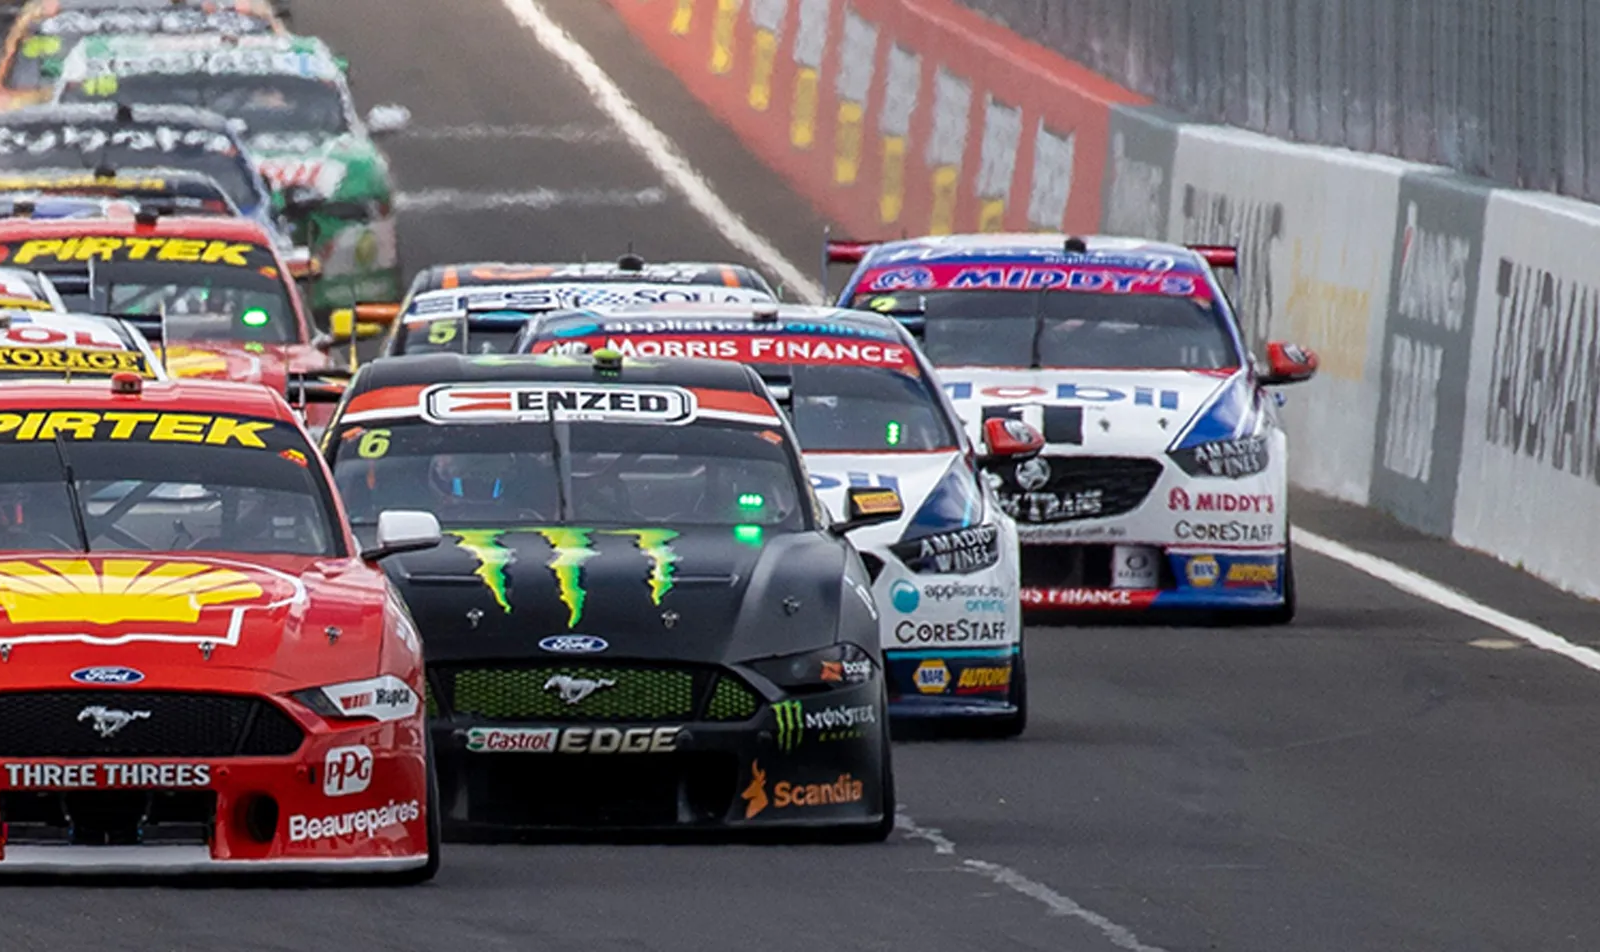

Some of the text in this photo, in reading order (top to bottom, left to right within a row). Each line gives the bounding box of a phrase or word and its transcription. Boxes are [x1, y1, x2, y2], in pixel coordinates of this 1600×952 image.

[12, 238, 256, 267] PIRTEK
[949, 267, 1196, 296] MIDDY'S
[428, 319, 458, 344] 5
[606, 338, 738, 357] MORRIS
[751, 340, 904, 363] FINANCE
[515, 388, 670, 412] ENZED
[357, 427, 392, 459] 6
[1195, 493, 1274, 513] MIDDY'S
[934, 546, 991, 572] WINES
[1047, 589, 1132, 606] FINANCE
[548, 636, 600, 652] Ford
[82, 667, 131, 683] Ford
[486, 725, 684, 754] Castrol EDGE
[4, 763, 212, 787] THREE THREES
[326, 750, 373, 791] PPG
[773, 773, 864, 809] Scandia
[288, 799, 420, 842] Beaurepaires
